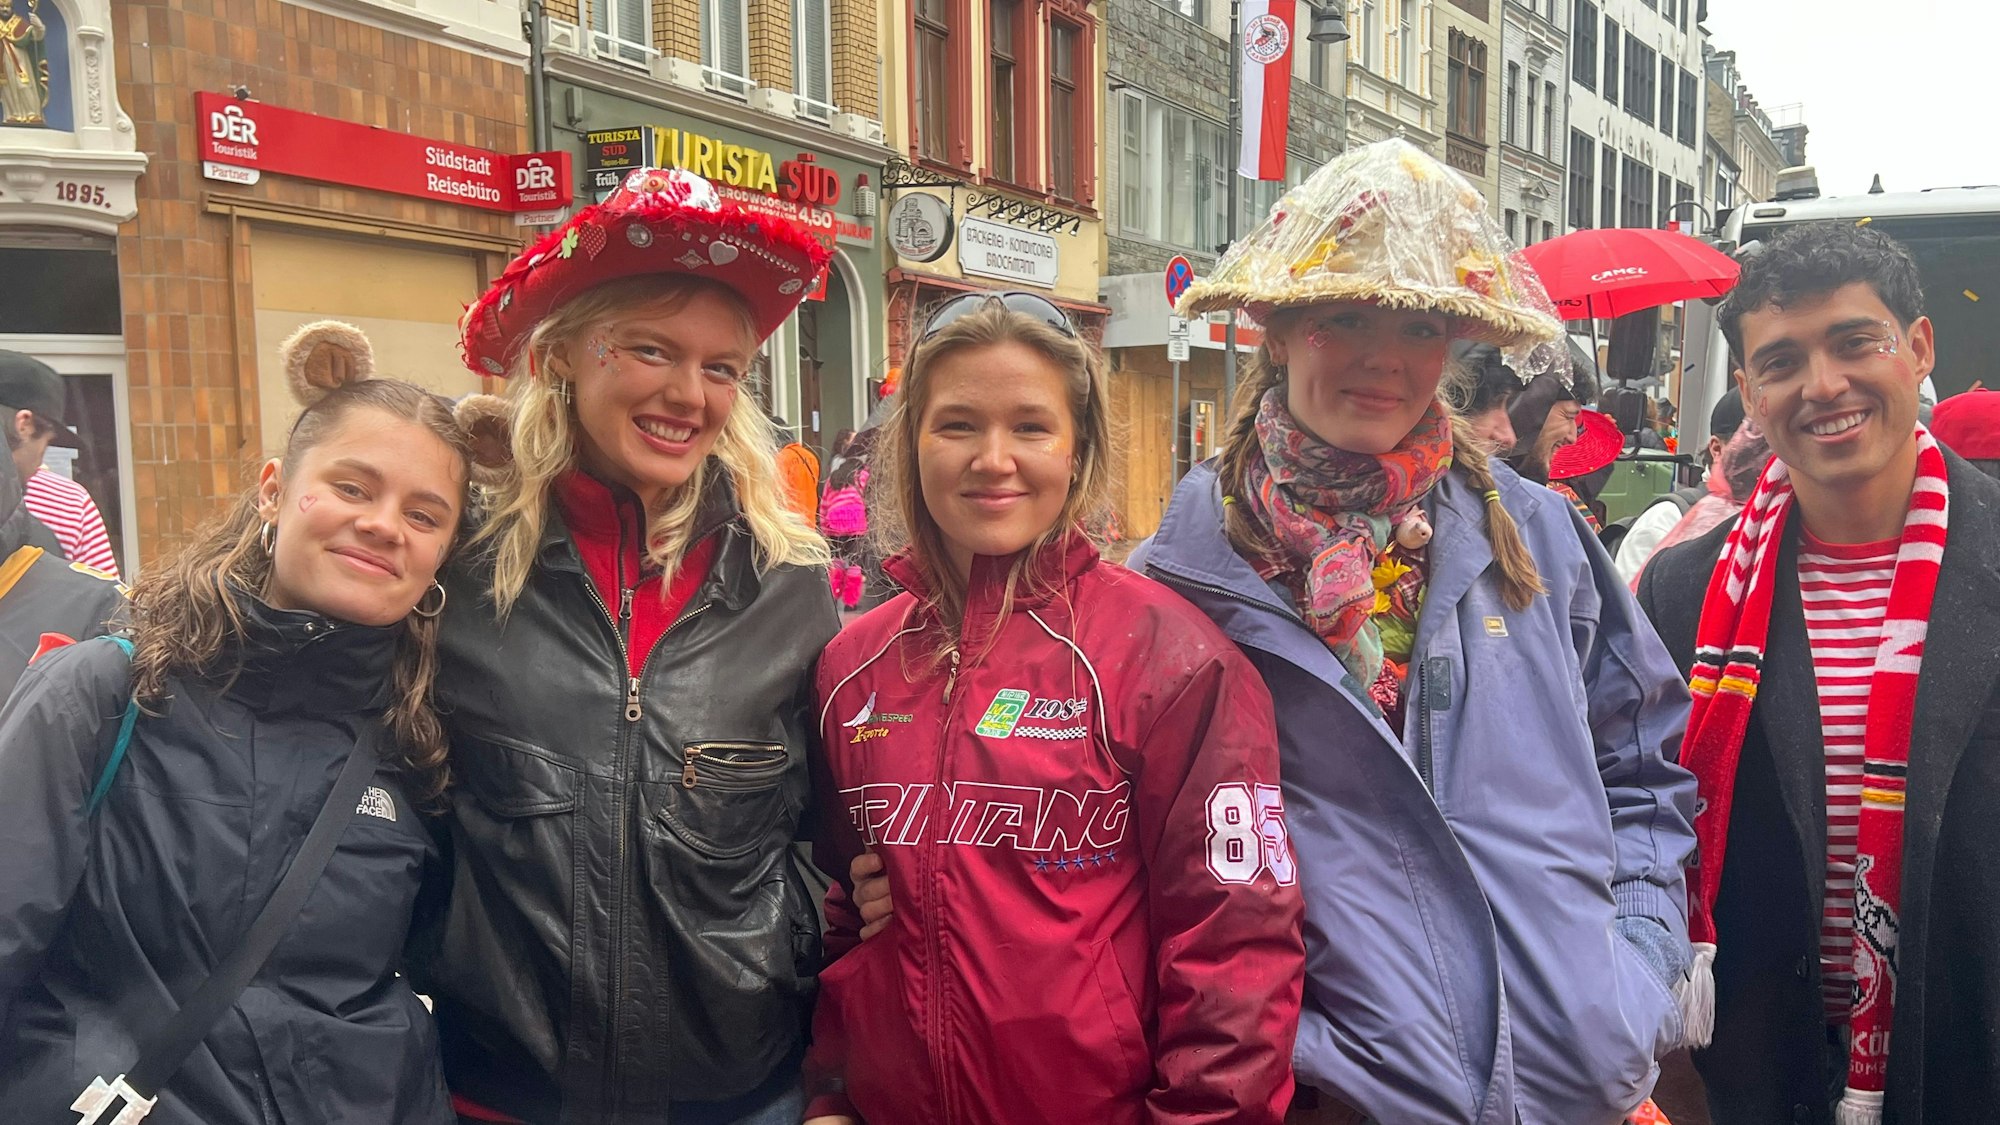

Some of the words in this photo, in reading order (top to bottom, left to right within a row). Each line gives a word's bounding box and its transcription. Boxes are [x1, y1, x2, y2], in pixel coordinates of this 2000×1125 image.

[211, 111, 259, 146] DER
[588, 129, 641, 144] TURISTA
[212, 141, 257, 160] Touristik
[601, 143, 628, 156] SÜD
[425, 146, 492, 176] Südstadt
[654, 126, 778, 194] TURISTA
[786, 153, 841, 206] SÜD
[211, 165, 249, 181] Partner
[516, 165, 556, 190] DER
[595, 172, 620, 187] früh
[427, 173, 501, 203] Reisebüro
[519, 190, 557, 202] Touristik
[718, 186, 797, 214] BRODWOOSCH
[524, 213, 556, 224] Partner
[798, 206, 832, 229] 4,50
[966, 226, 1005, 249] BÄCKEREI
[1591, 266, 1648, 282] CAMEL
[356, 804, 382, 817] FACE
[1205, 781, 1297, 887] 85
